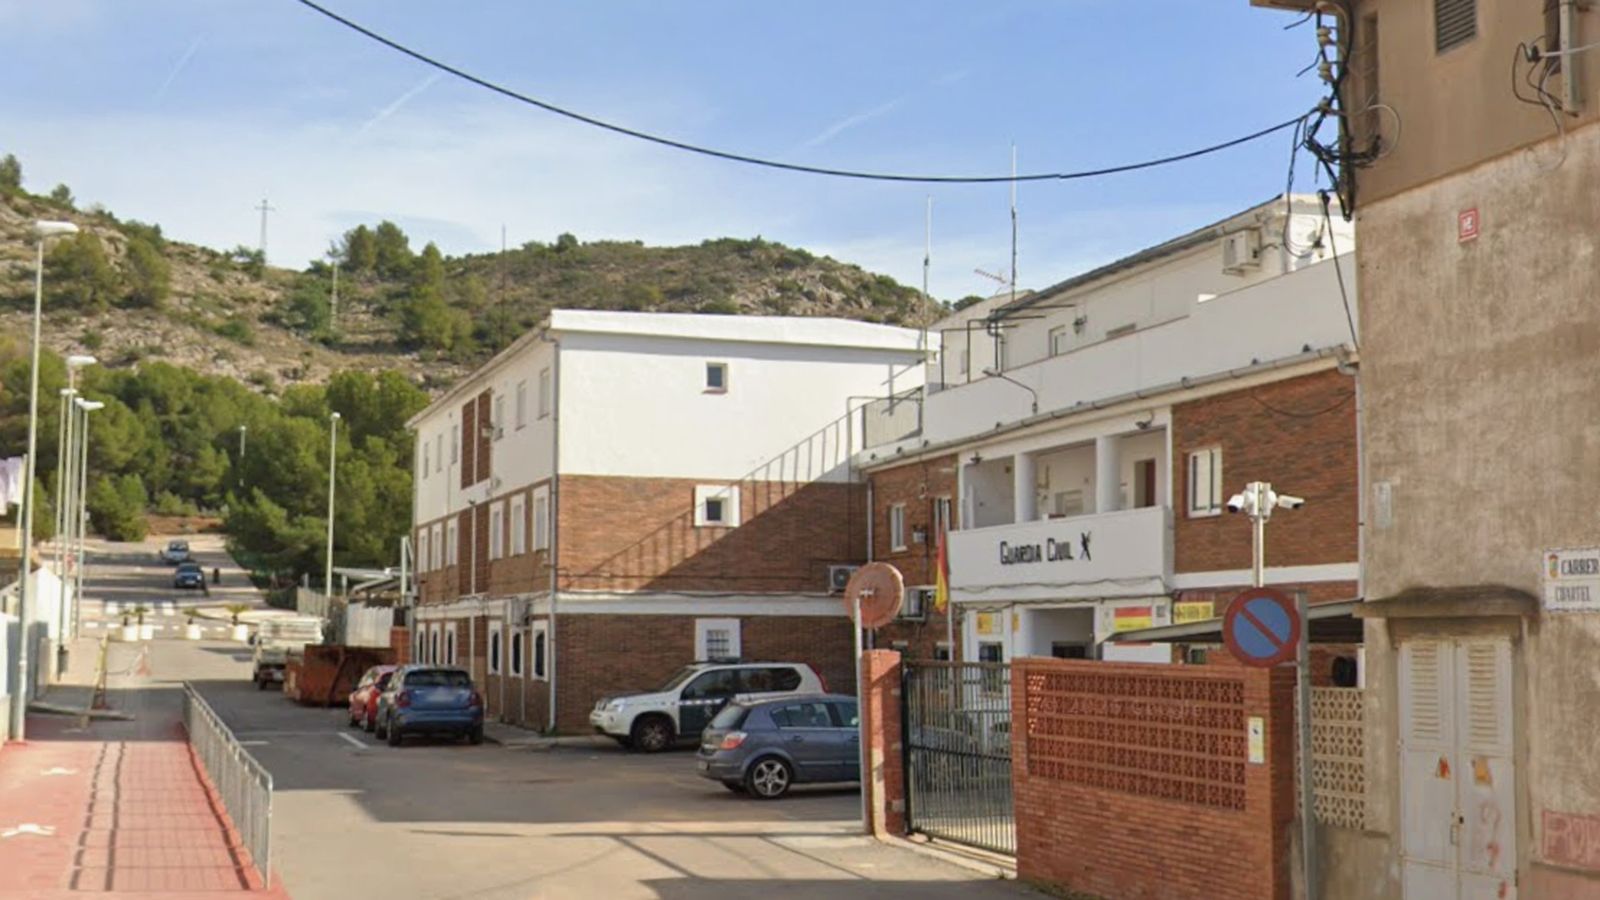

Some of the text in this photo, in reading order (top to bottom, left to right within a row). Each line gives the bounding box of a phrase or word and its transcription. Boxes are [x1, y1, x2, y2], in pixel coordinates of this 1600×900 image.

[1000, 537, 1074, 565] GUARDIA CIVIL
[1561, 558, 1600, 575] CARRER
